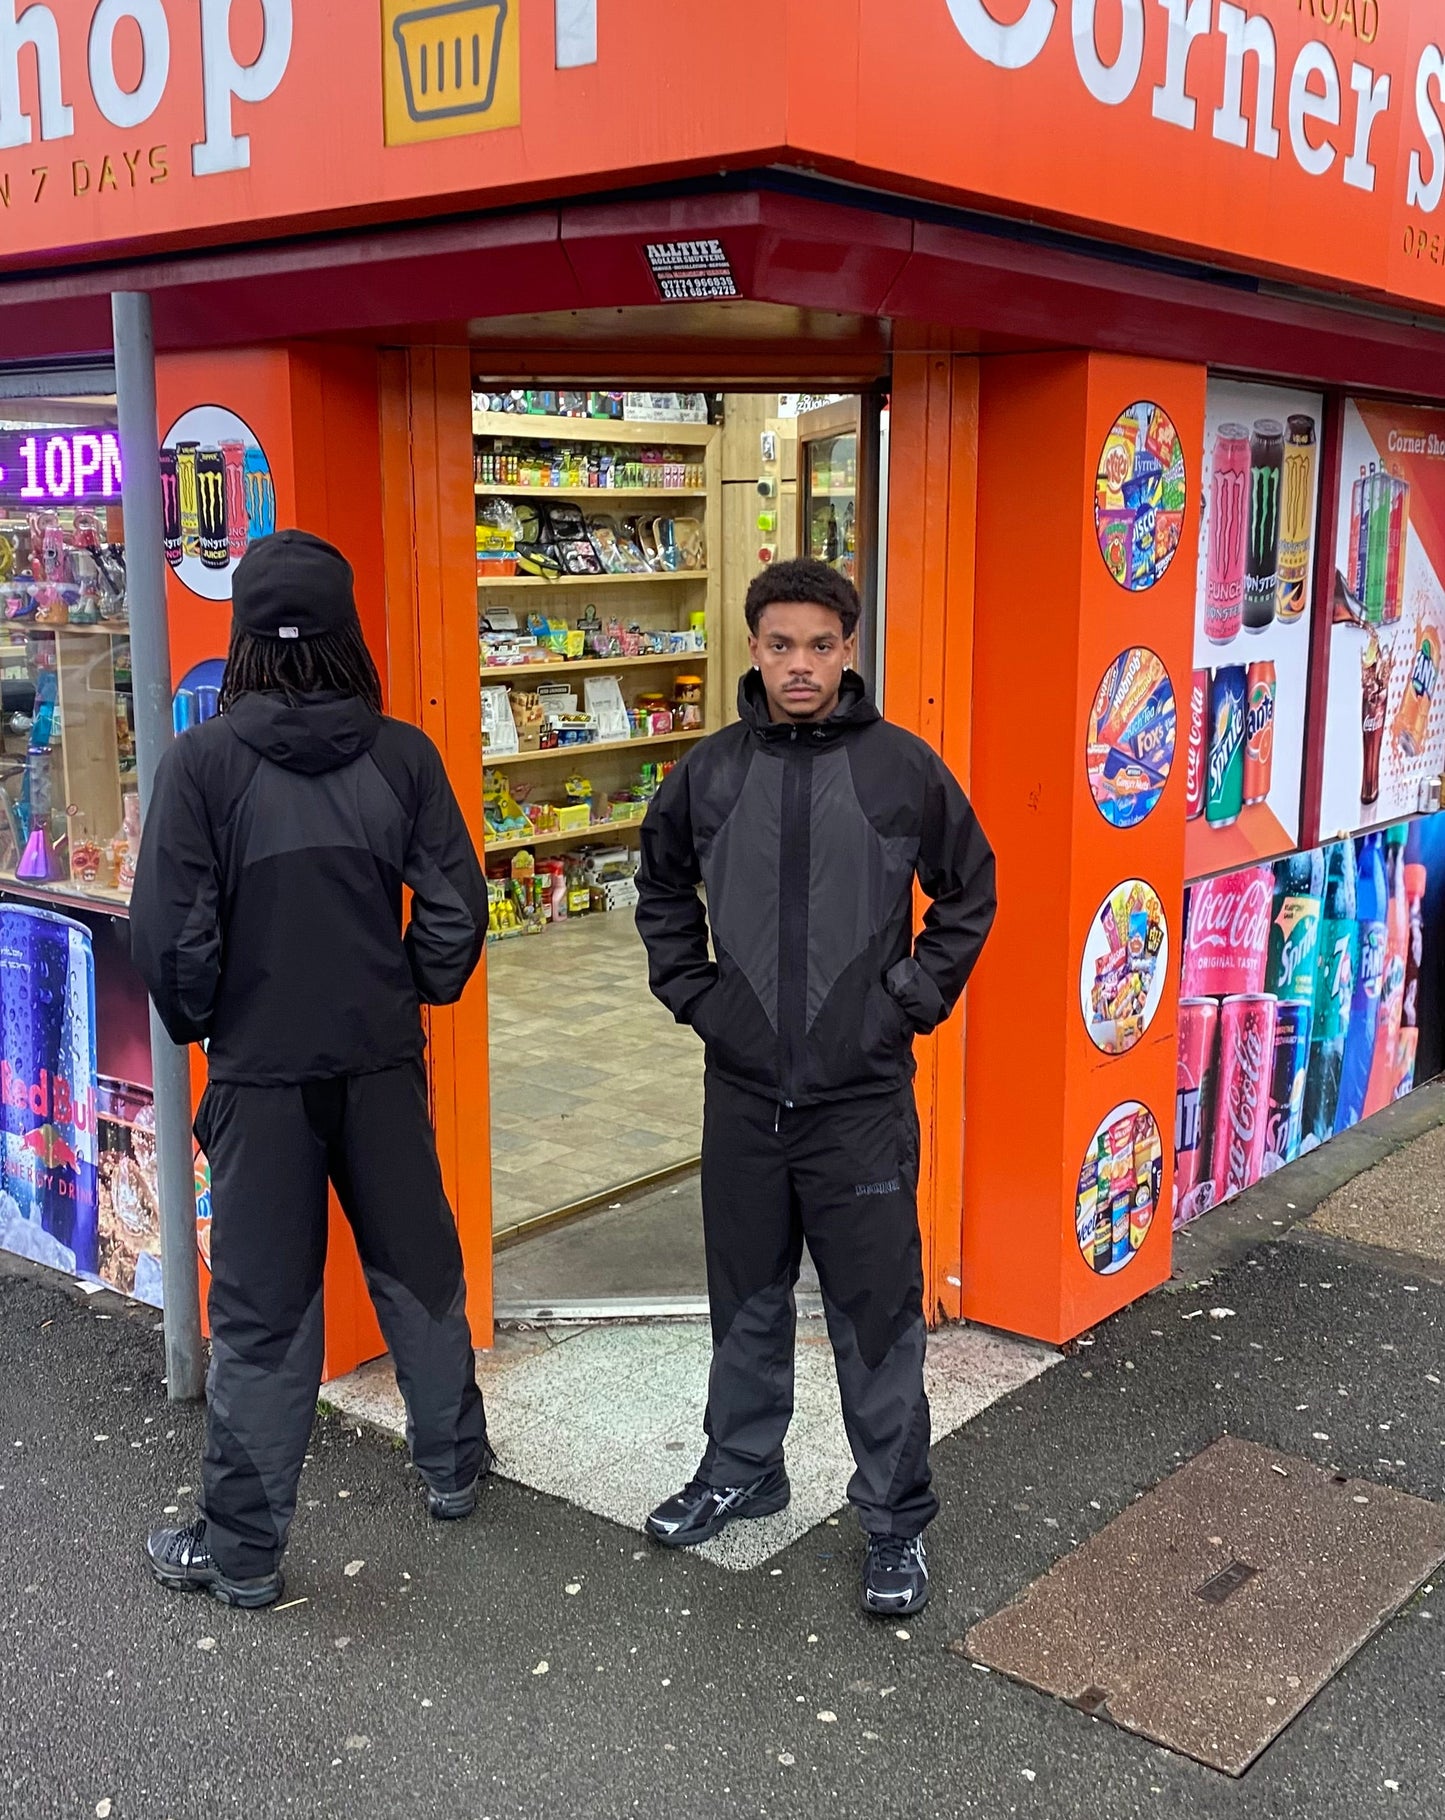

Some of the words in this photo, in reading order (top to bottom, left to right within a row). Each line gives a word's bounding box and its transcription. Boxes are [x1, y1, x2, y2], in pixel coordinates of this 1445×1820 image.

[31, 166, 49, 203] 7
[71, 144, 169, 196] DAYS
[646, 240, 722, 258] ALLTITE
[650, 256, 684, 265] ROLLER
[661, 279, 693, 290] 07774
[664, 287, 689, 298] 0161
[1388, 429, 1427, 454] Corner
[1210, 707, 1243, 797] Sprite
[1197, 956, 1234, 969] ORIGINAL
[0, 1060, 48, 1118] Red
